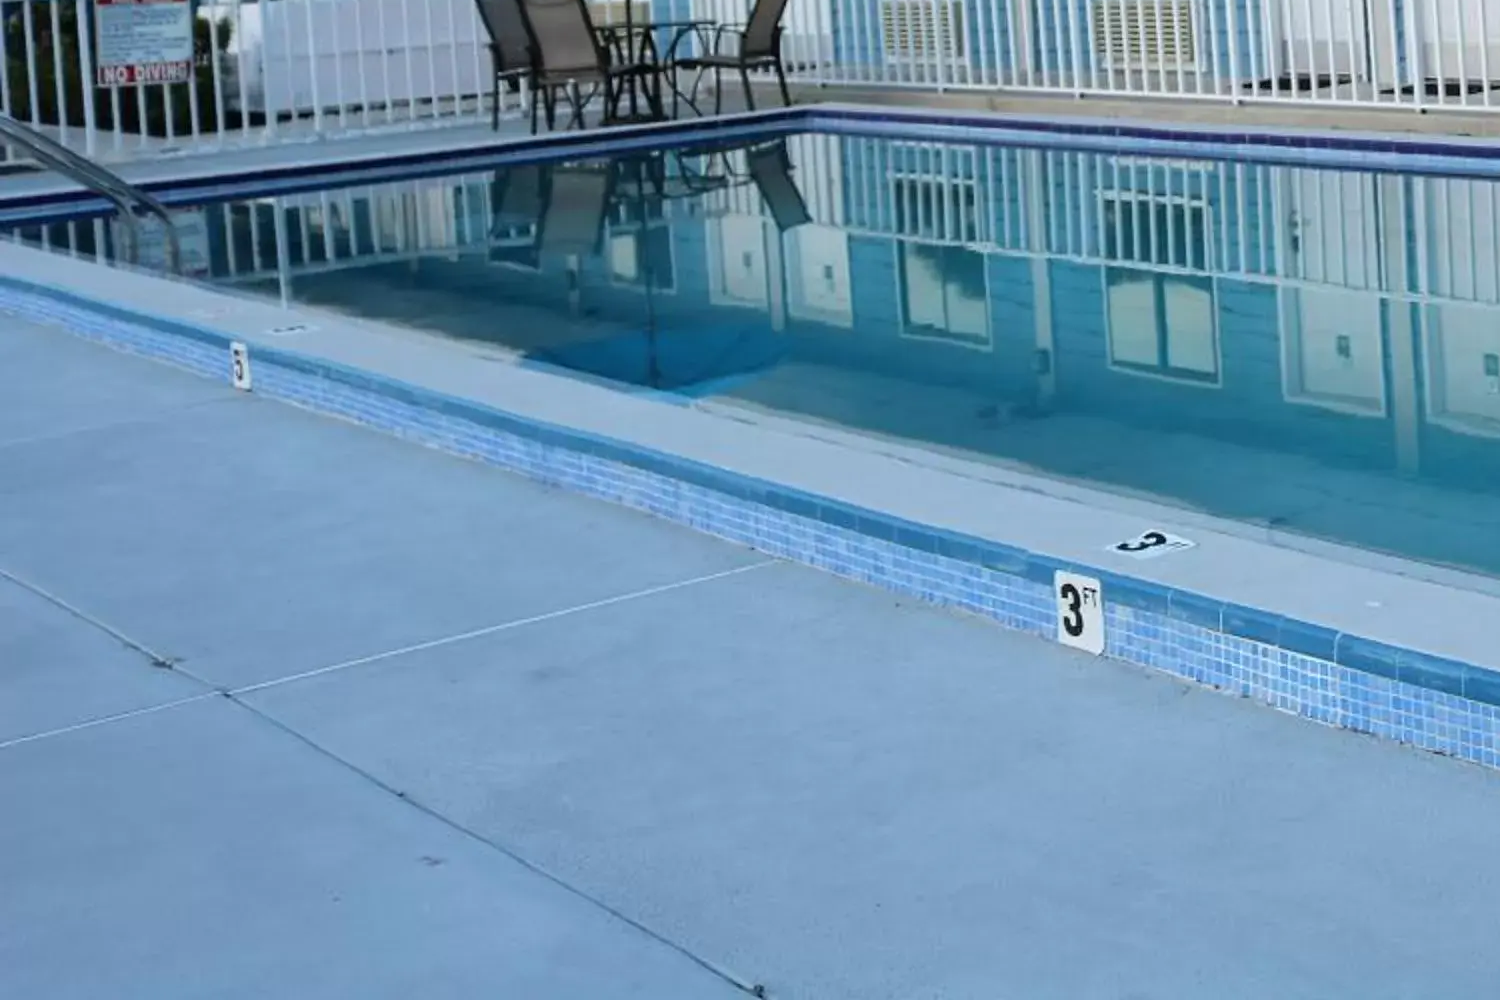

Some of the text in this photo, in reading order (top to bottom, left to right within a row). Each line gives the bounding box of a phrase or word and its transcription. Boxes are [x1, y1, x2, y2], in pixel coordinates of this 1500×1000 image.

[104, 62, 188, 81] NO DIVING
[1115, 531, 1167, 551] 3
[1060, 583, 1098, 638] 3 FT
